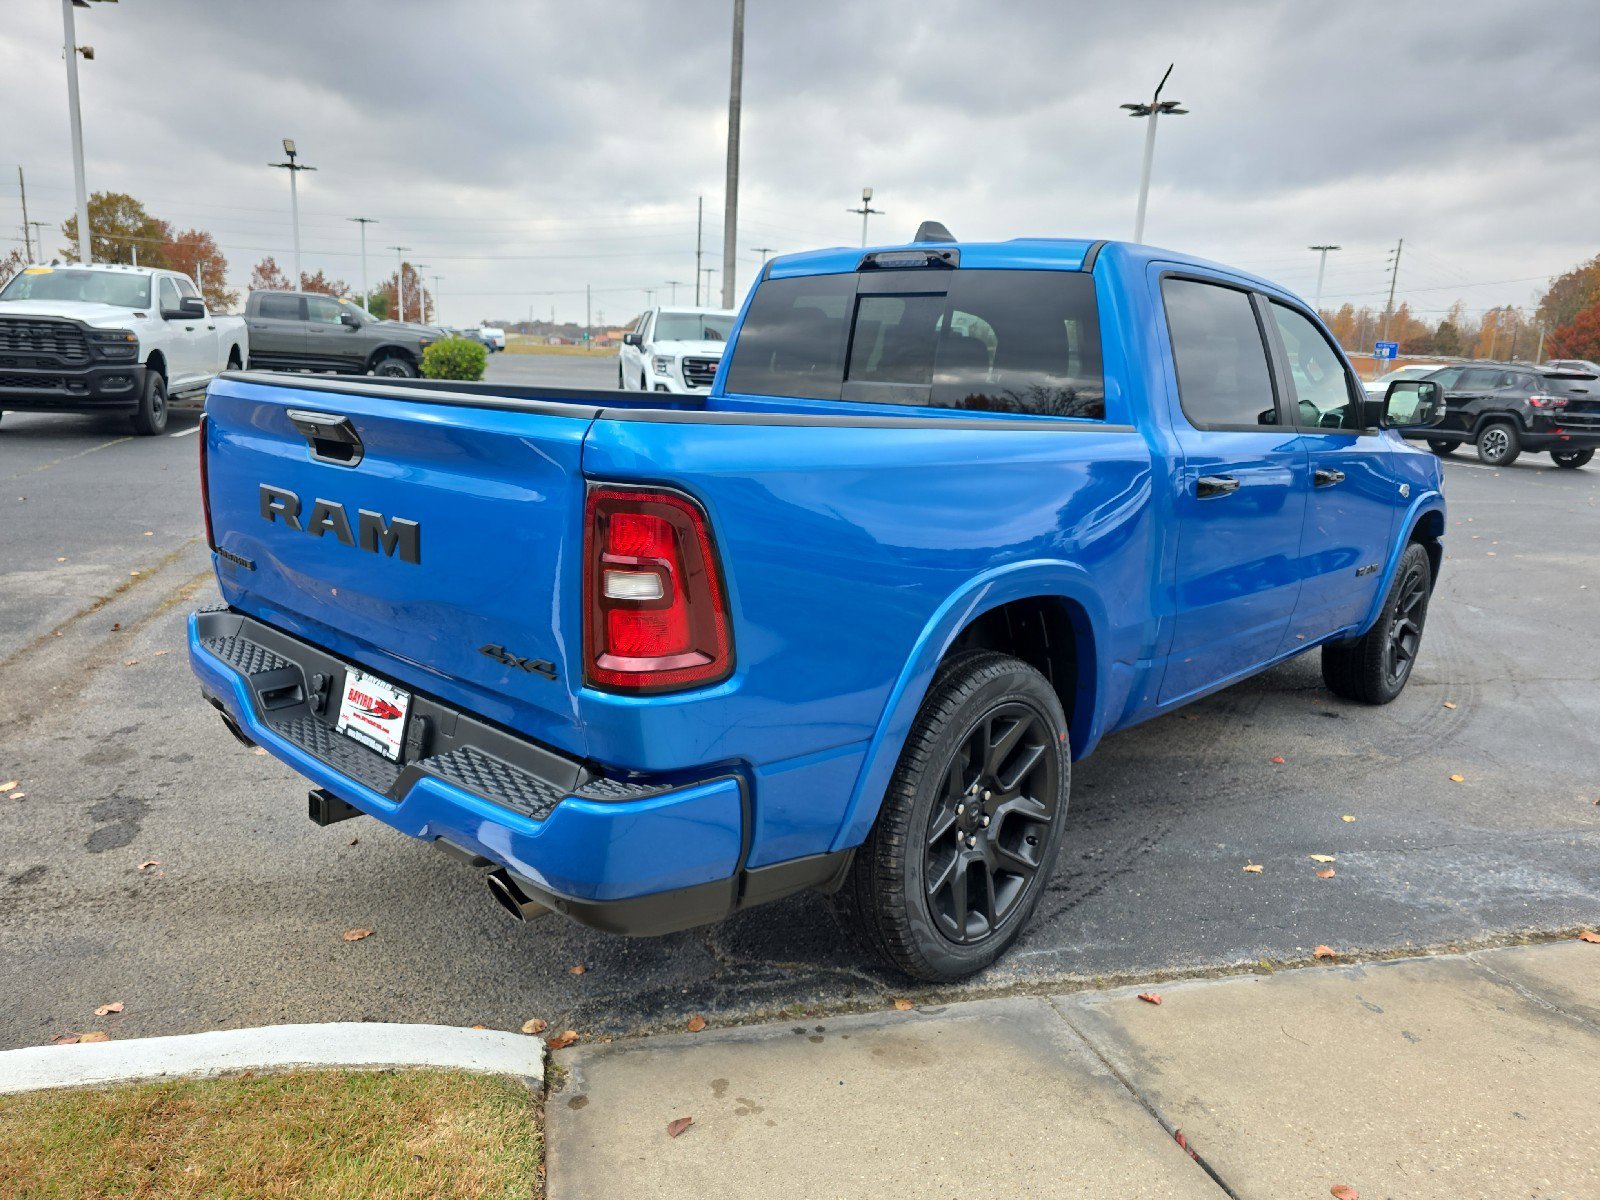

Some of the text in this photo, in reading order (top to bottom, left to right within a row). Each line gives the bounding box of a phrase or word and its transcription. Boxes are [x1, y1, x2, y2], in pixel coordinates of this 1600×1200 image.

[259, 483, 421, 565] RAM
[479, 643, 559, 680] 4x4
[348, 688, 373, 709] BAYIRD
